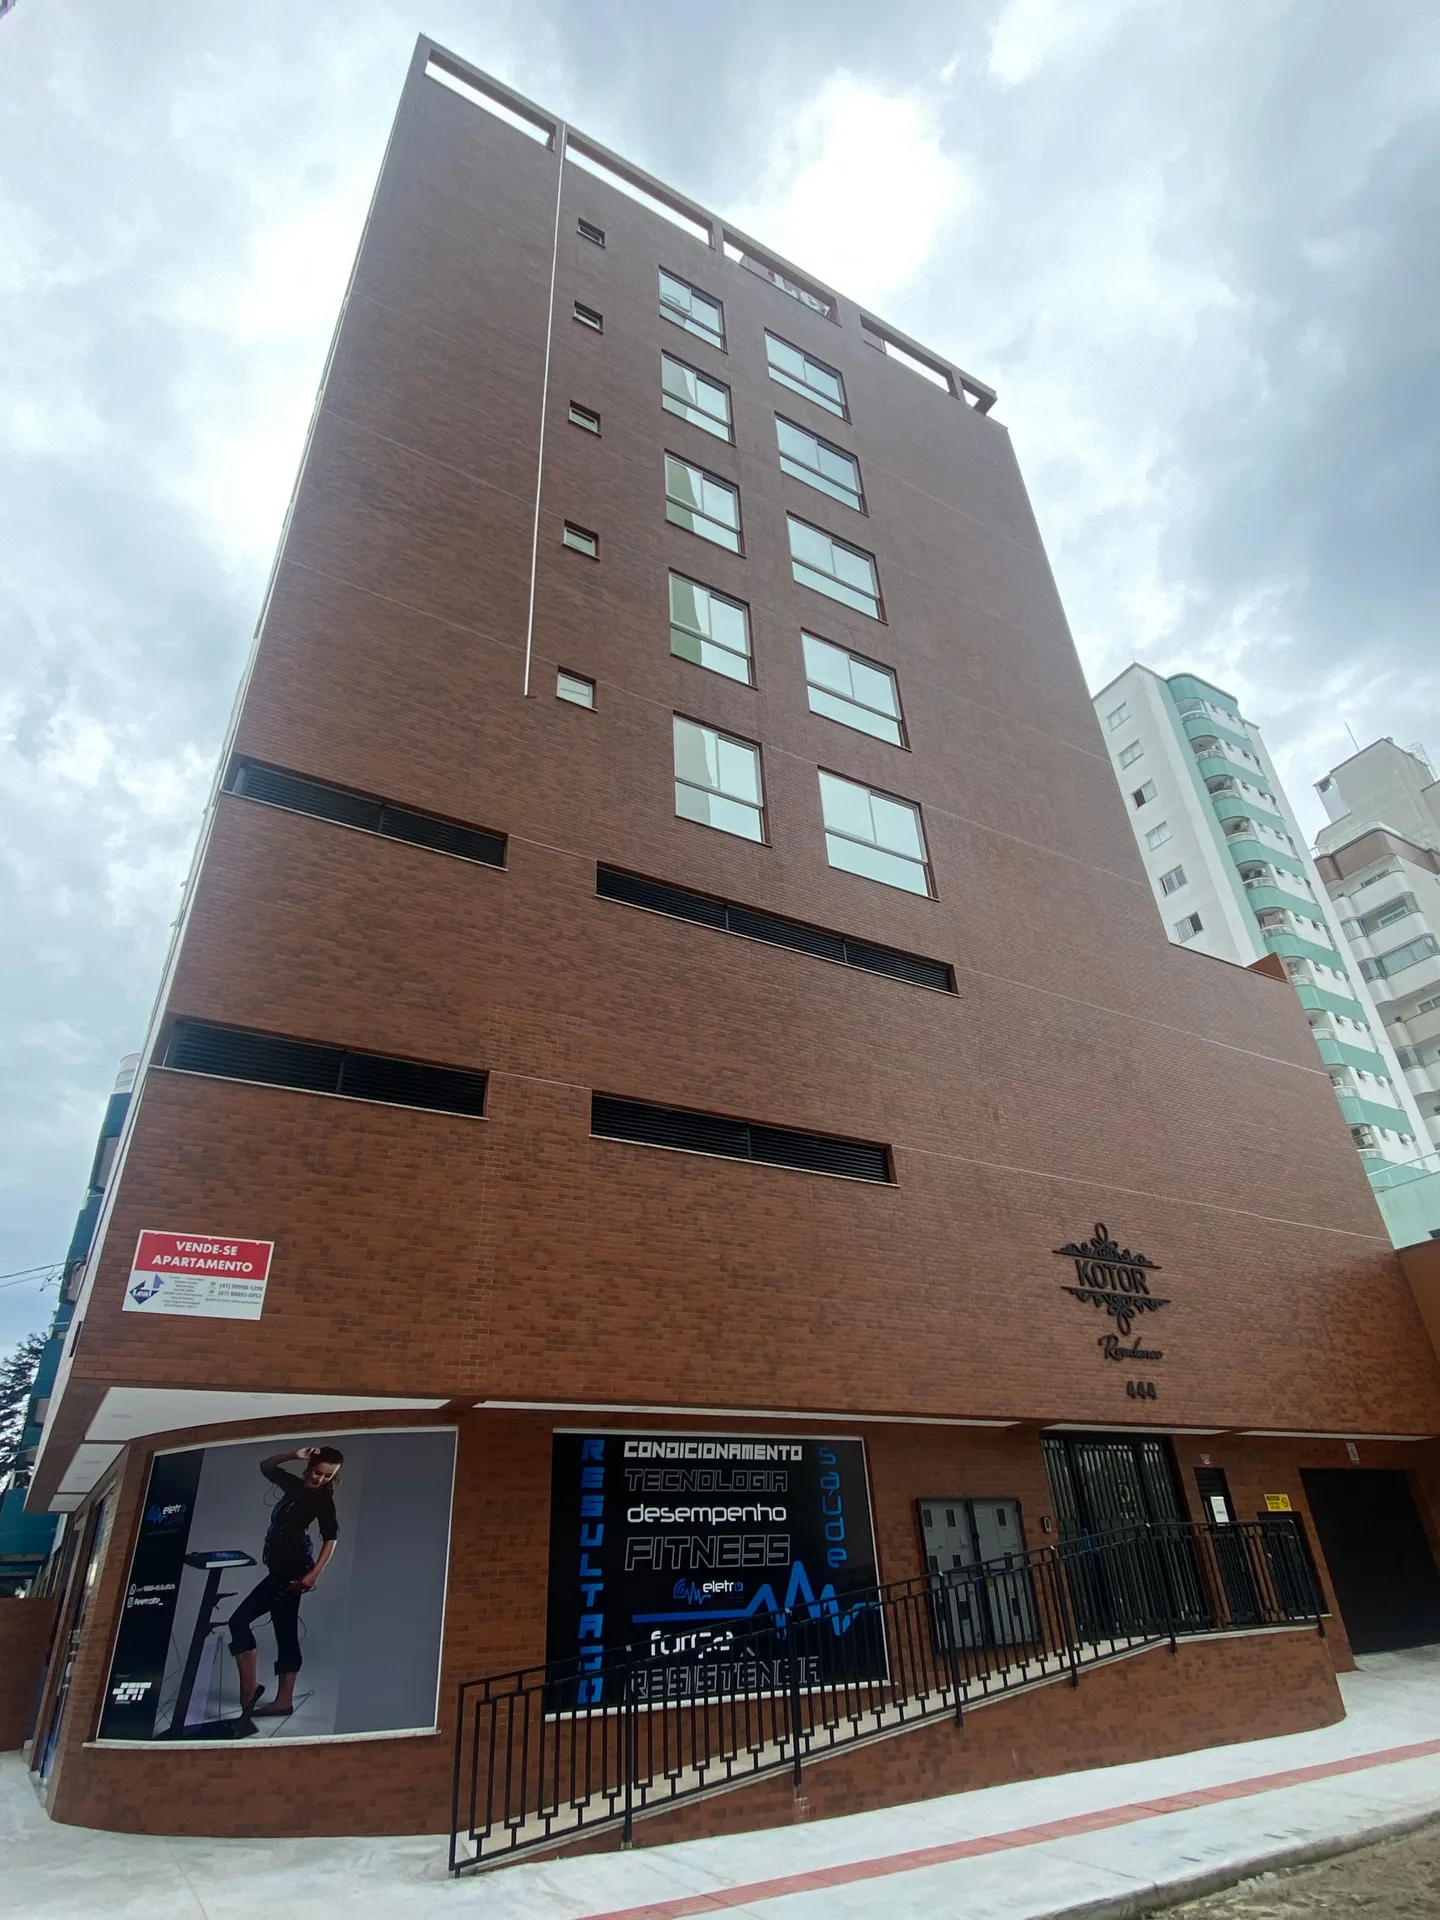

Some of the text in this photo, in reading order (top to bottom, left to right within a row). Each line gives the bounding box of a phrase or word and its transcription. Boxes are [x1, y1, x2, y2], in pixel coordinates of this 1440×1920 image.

[175, 1240, 239, 1256] VENDE-SE
[151, 1254, 254, 1273] APARTAMENTO
[1074, 1259, 1150, 1295] KOTOR
[1126, 1380, 1158, 1400] 444
[623, 1440, 803, 1461] CONDICIONAMENTO
[624, 1468, 788, 1492] TECNOLOGIA
[626, 1502, 787, 1525] desempenho
[624, 1533, 791, 1571] FITNESS
[577, 1439, 605, 1705] RESULTADO
[702, 1579, 744, 1593] eletro
